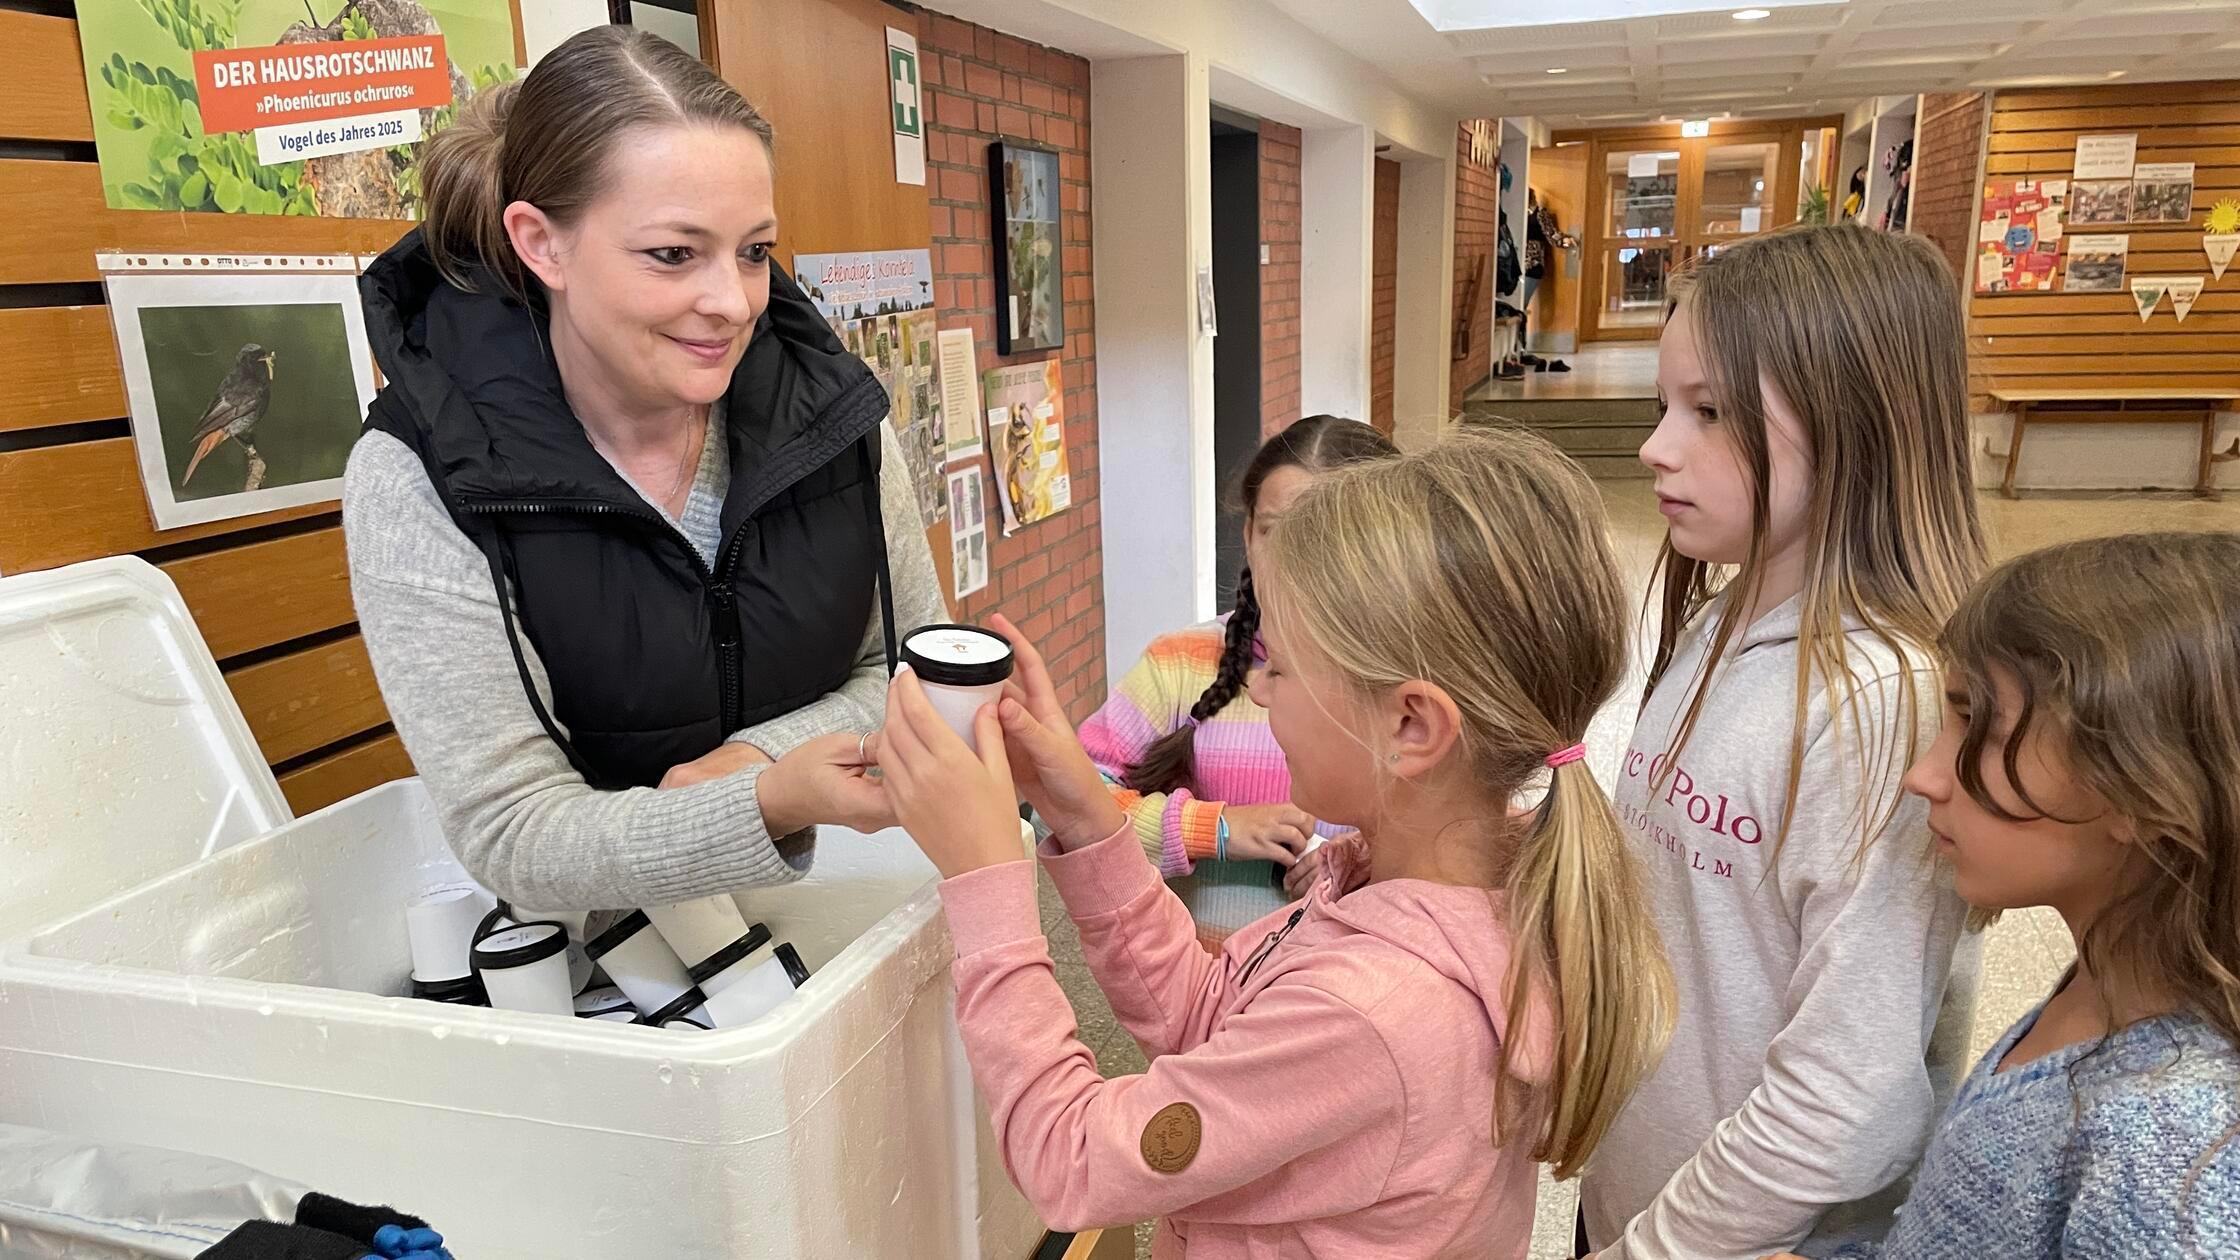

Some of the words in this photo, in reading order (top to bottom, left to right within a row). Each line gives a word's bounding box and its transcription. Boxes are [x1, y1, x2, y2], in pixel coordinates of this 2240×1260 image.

[213, 61, 257, 88] DER
[260, 46, 434, 83] HAUSROTSCHWANZ
[256, 89, 352, 114] »Phoenicurus
[353, 83, 415, 103] ochruros«
[279, 128, 313, 152] Vogel
[316, 130, 336, 144] des
[339, 126, 376, 142] Jahres
[377, 120, 403, 137] 2025
